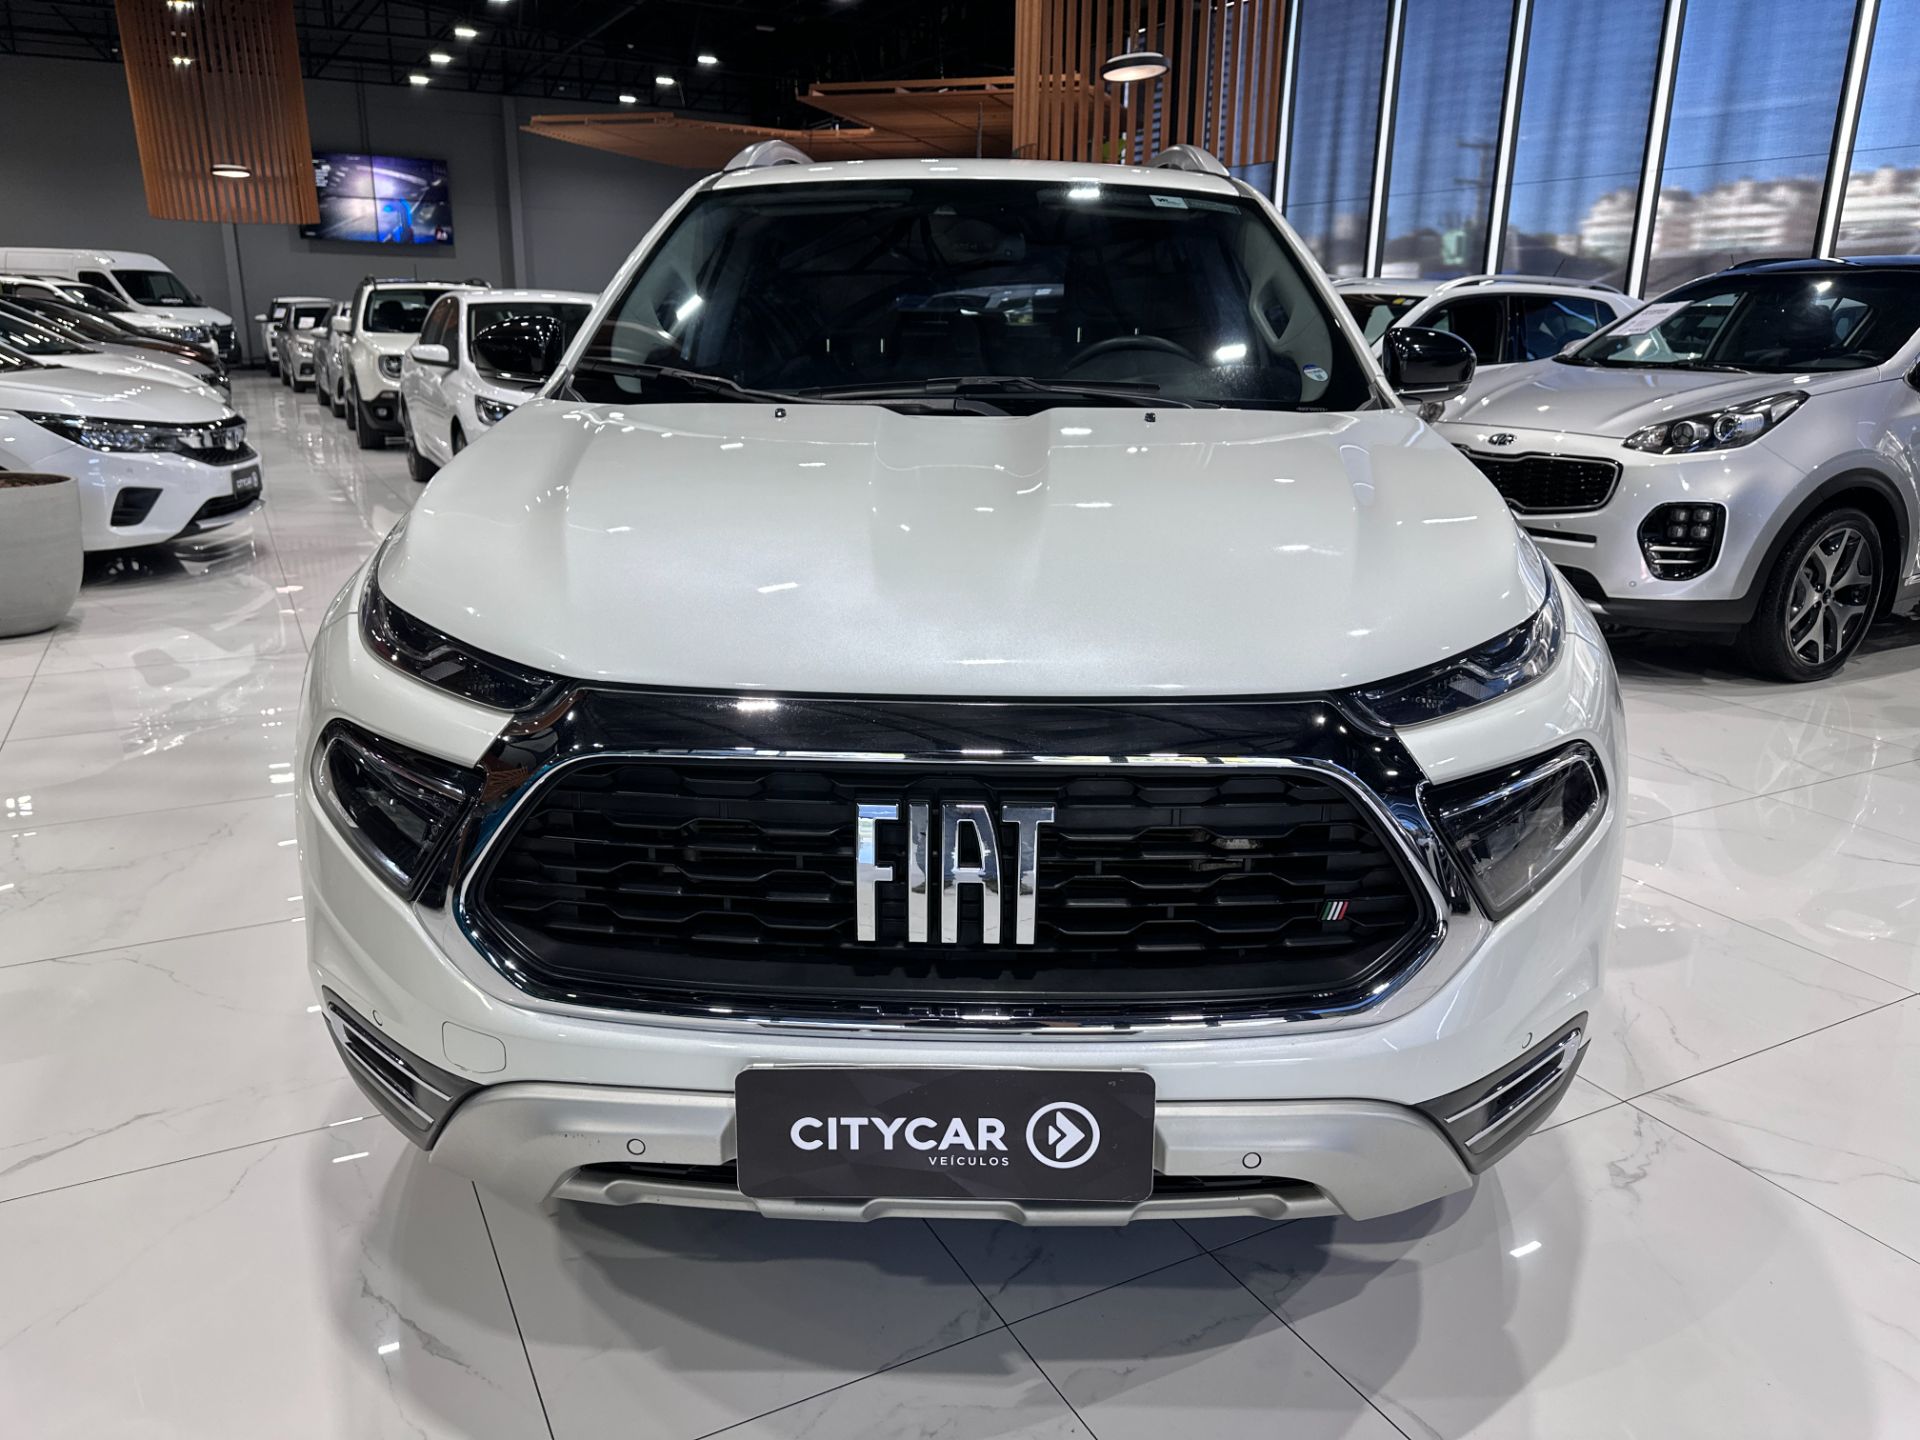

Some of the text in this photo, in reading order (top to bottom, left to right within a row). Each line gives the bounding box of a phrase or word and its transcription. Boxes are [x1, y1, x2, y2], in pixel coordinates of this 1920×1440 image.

[854, 802, 1056, 945] FIAT
[790, 1116, 1008, 1151] CITYCAR
[928, 1154, 1009, 1166] VEÍCULOS
